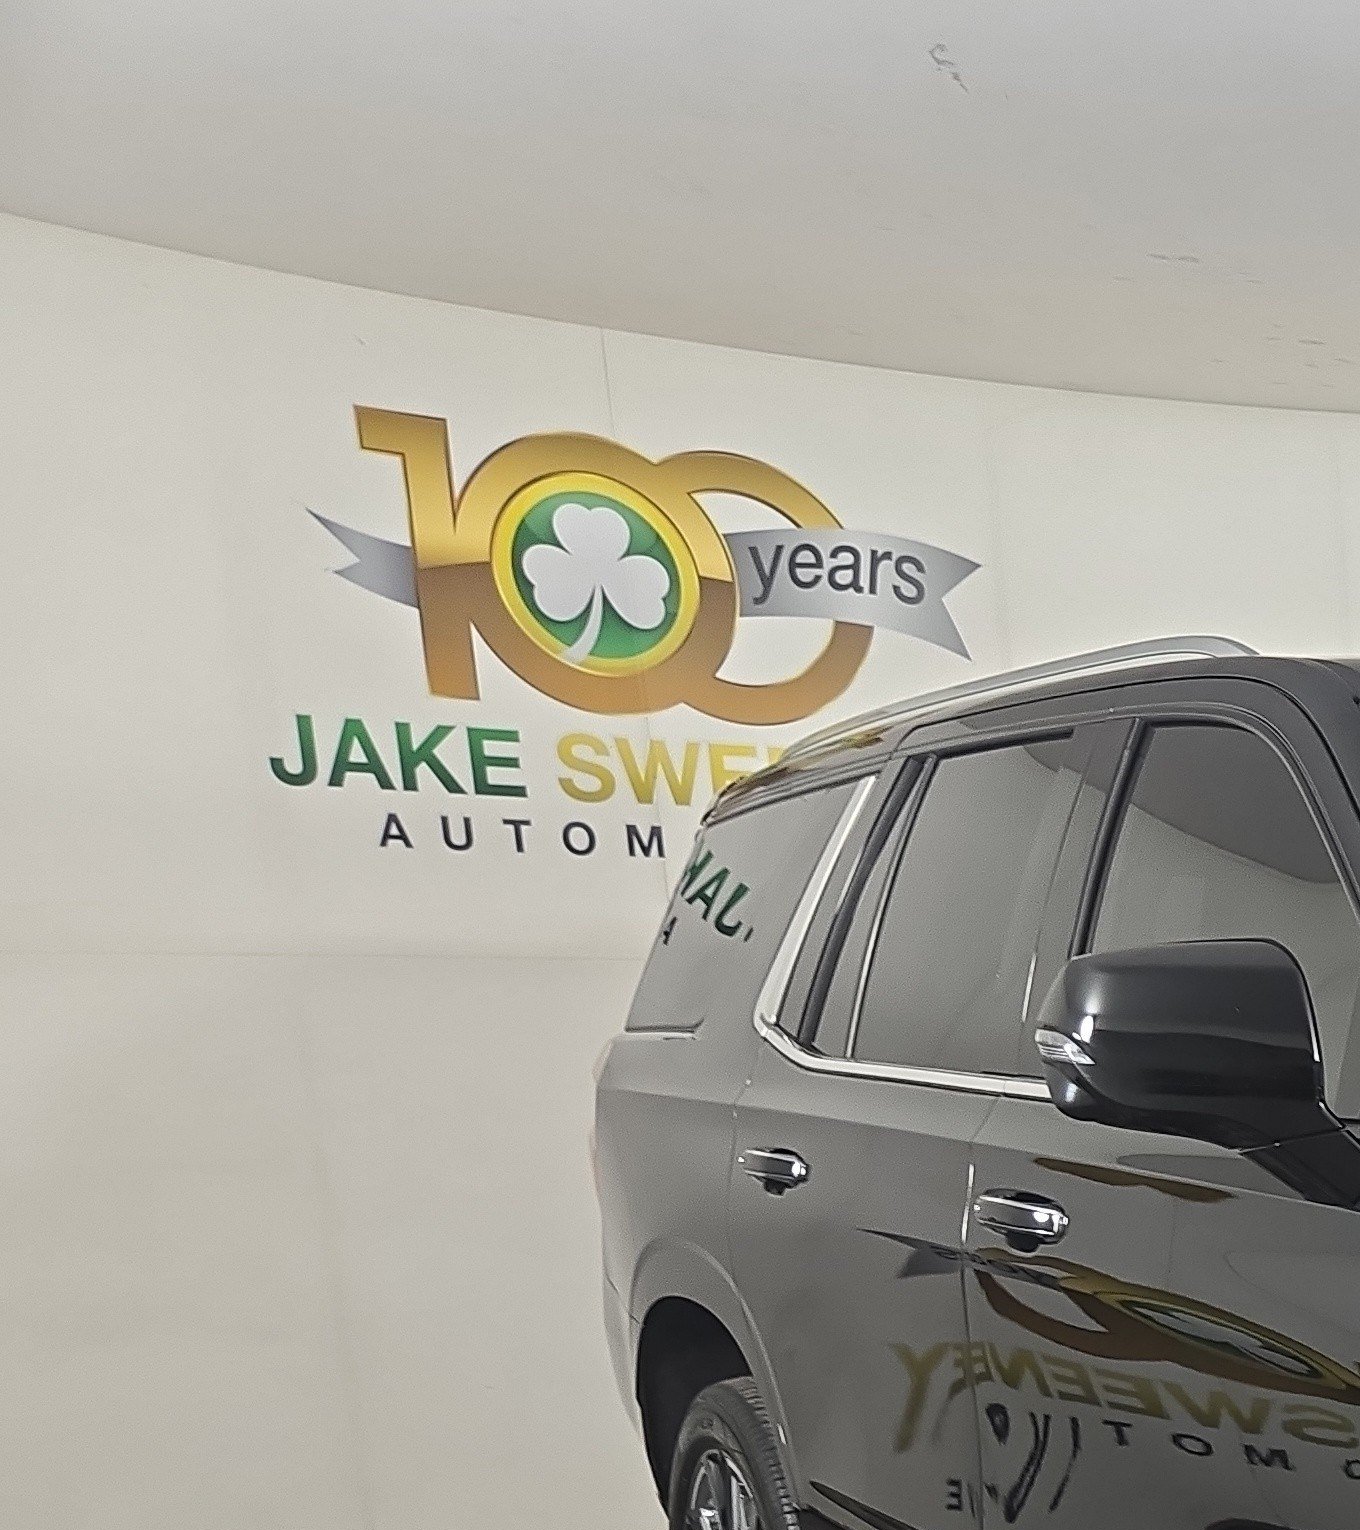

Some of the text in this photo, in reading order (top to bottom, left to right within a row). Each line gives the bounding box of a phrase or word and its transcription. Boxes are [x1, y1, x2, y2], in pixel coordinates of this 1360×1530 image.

[353, 404, 928, 726] 100 years
[268, 713, 790, 807] JAKE SWE
[379, 812, 666, 859] AUTOM
